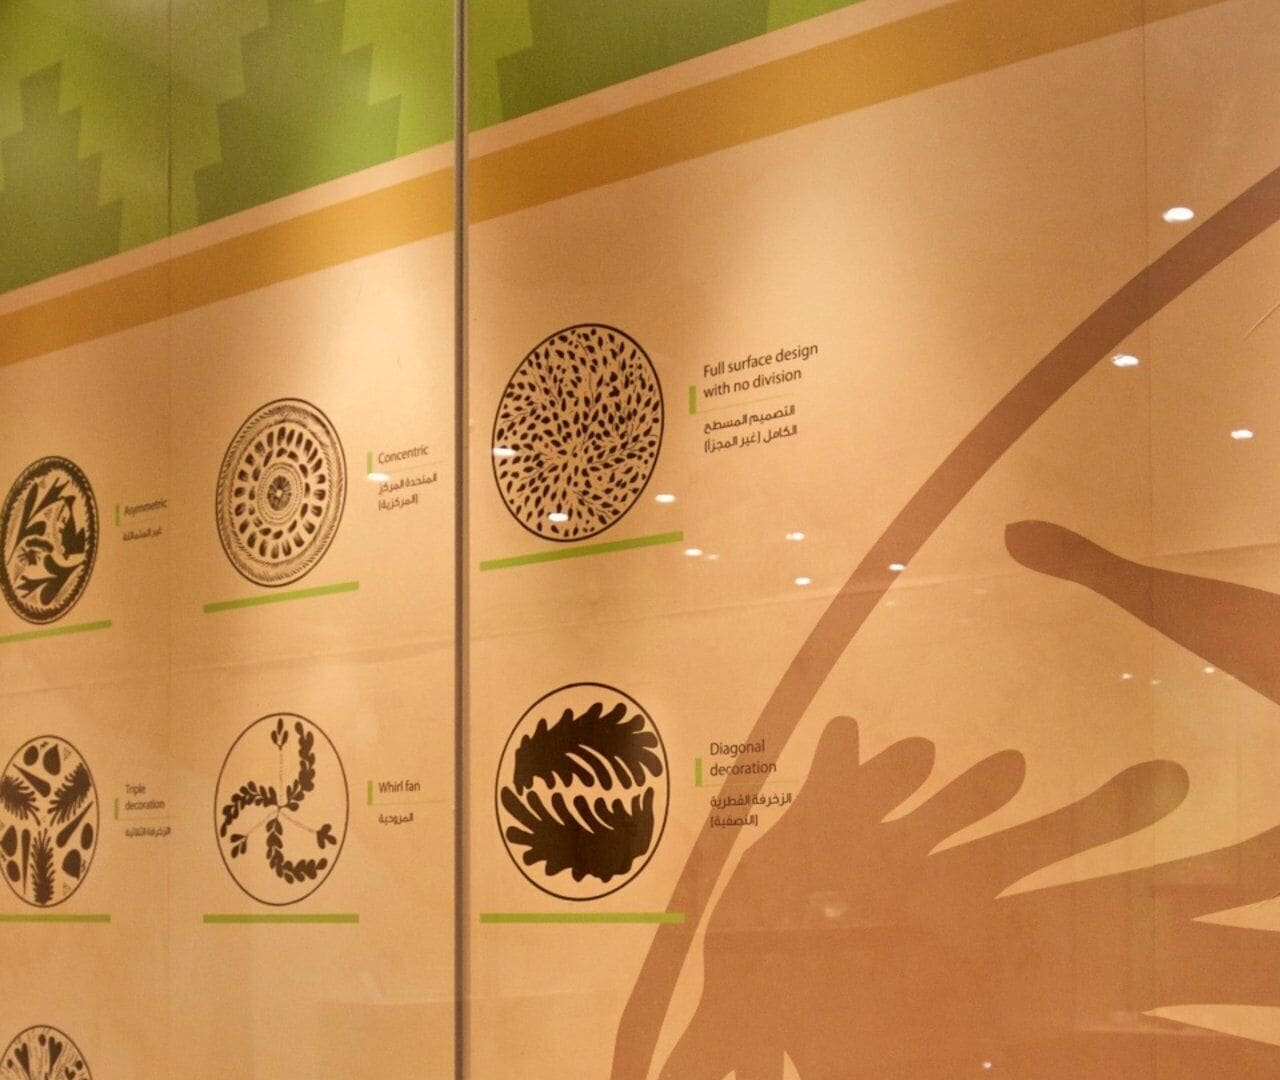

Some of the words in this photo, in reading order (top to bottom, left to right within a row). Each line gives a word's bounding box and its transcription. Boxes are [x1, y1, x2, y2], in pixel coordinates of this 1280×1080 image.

[703, 361, 725, 378] Full
[728, 354, 773, 374] surface
[775, 344, 818, 362] design
[703, 382, 730, 399] with
[733, 380, 750, 392] no
[752, 369, 802, 388] division
[703, 414, 748, 434] المسطح
[749, 405, 795, 425] التصميم
[763, 424, 798, 443] الكامل
[378, 445, 429, 464] Concentric
[710, 739, 765, 758] Diagonal
[710, 760, 777, 776] decoration
[378, 780, 404, 793] Whirl
[404, 779, 421, 792] fan
